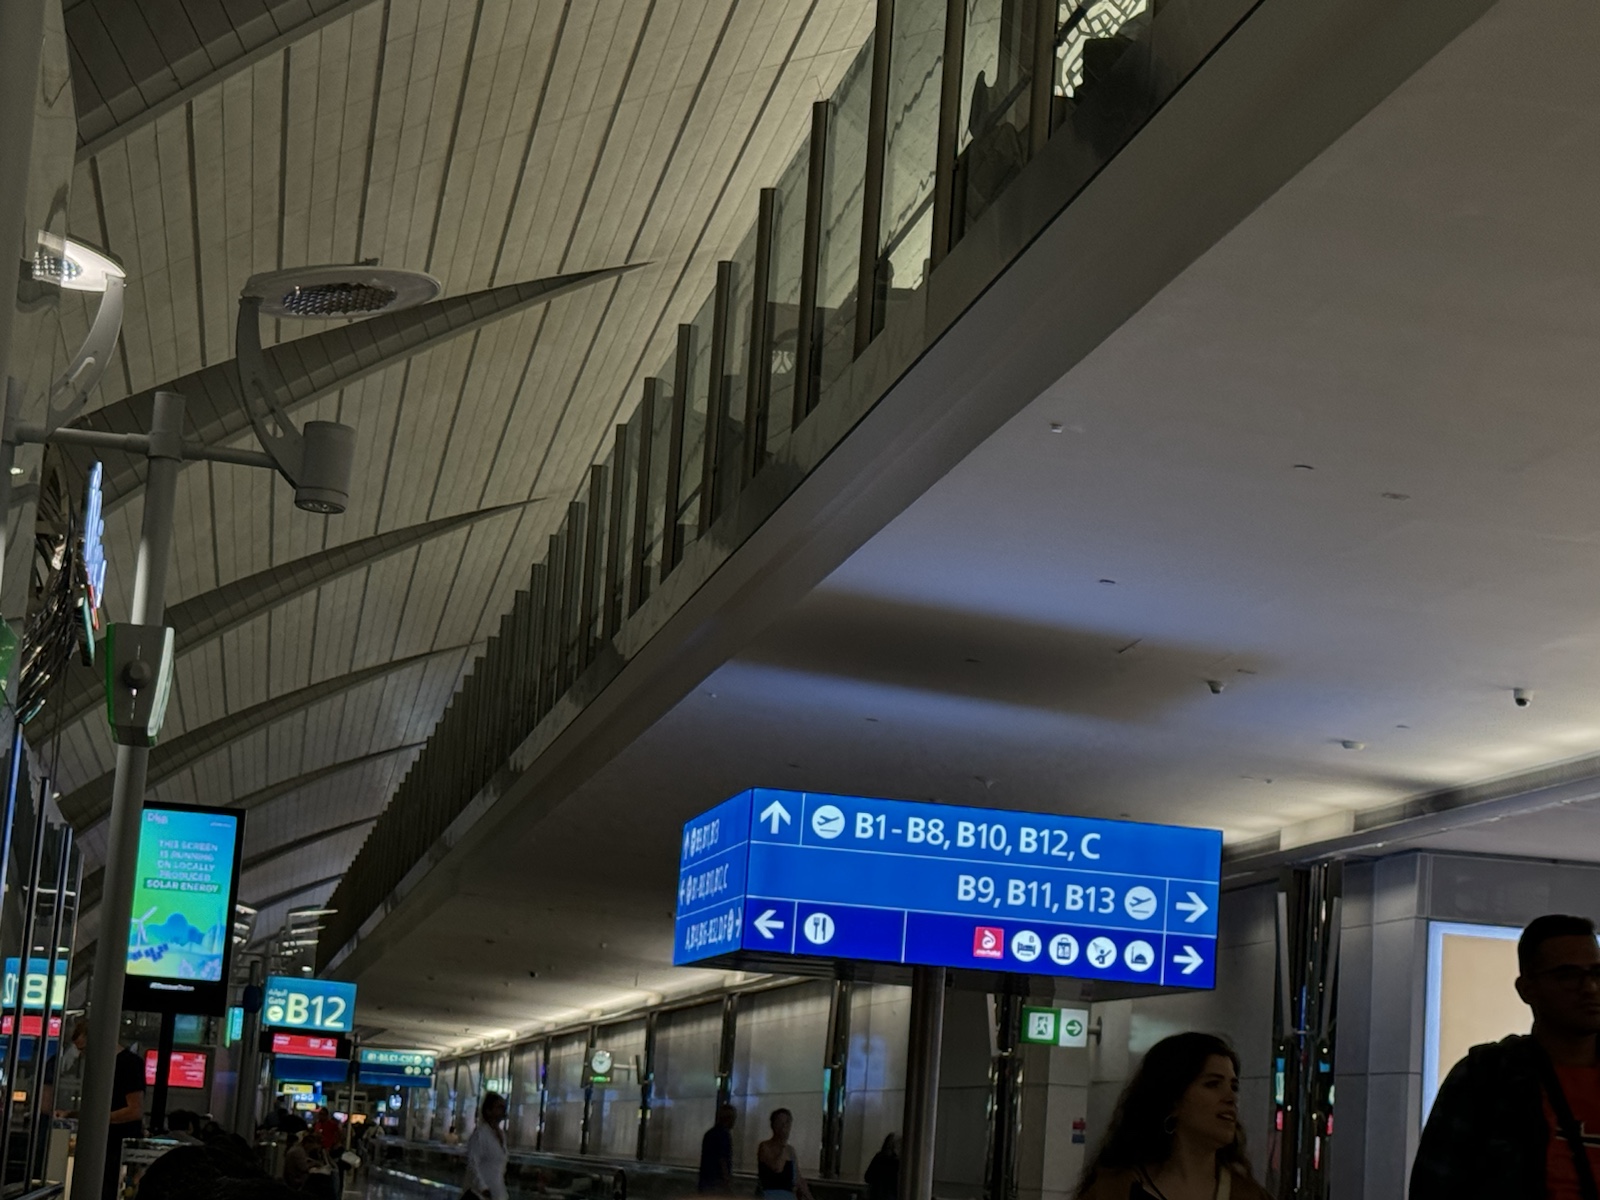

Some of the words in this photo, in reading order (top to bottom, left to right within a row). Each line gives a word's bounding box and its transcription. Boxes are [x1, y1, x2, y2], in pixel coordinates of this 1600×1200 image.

[181, 841, 218, 852] SCREEN
[956, 820, 1012, 856] B10,
[1019, 826, 1075, 862] B12,
[1080, 832, 1101, 860] C
[157, 859, 171, 869] ON
[174, 861, 216, 872] LOCALLY
[159, 869, 211, 882] PRODUCED
[146, 879, 179, 890] SOLAR
[180, 882, 219, 893] ENERGY
[957, 874, 1001, 909] B9,
[1007, 879, 1059, 914] B11,
[1065, 884, 1116, 914] B13
[285, 992, 346, 1029] B12
